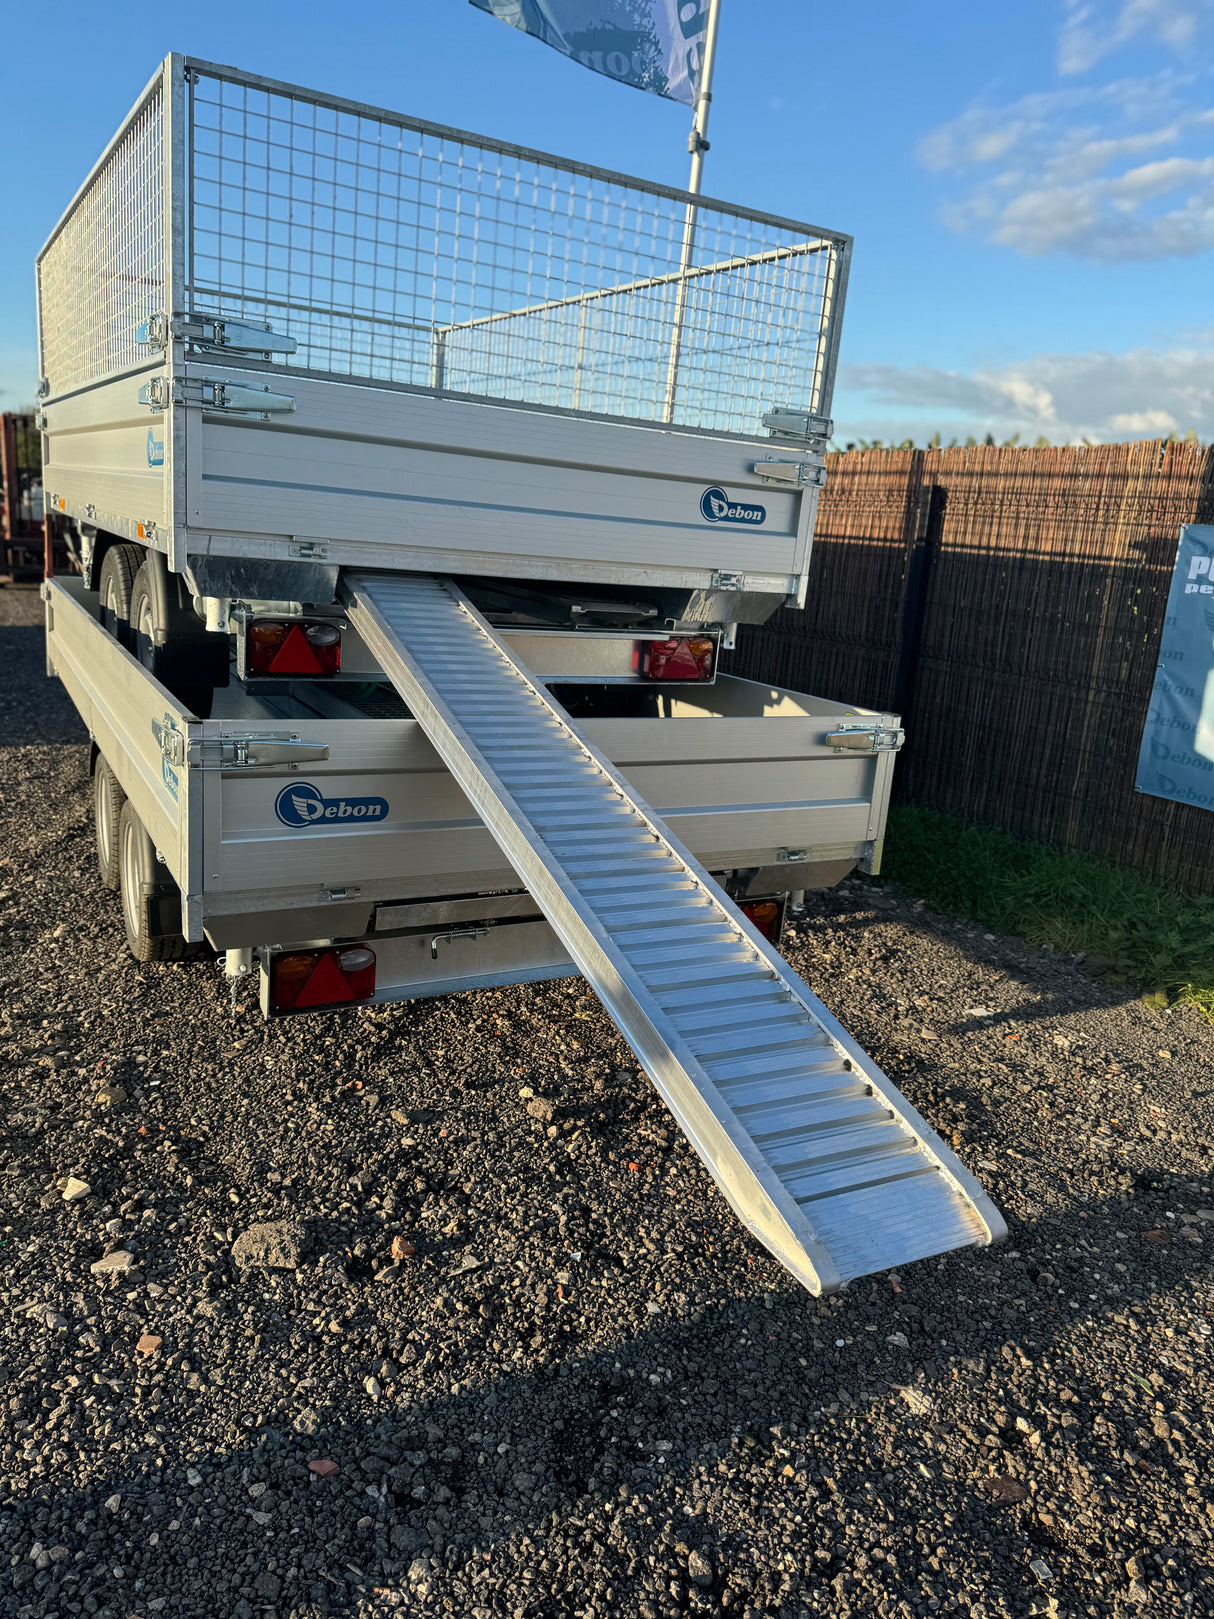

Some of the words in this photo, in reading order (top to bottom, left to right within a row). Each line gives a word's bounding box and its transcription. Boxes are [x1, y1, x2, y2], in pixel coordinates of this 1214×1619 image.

[710, 494, 762, 521] Debon
[1151, 736, 1214, 772] Debon
[291, 793, 382, 821] Debon
